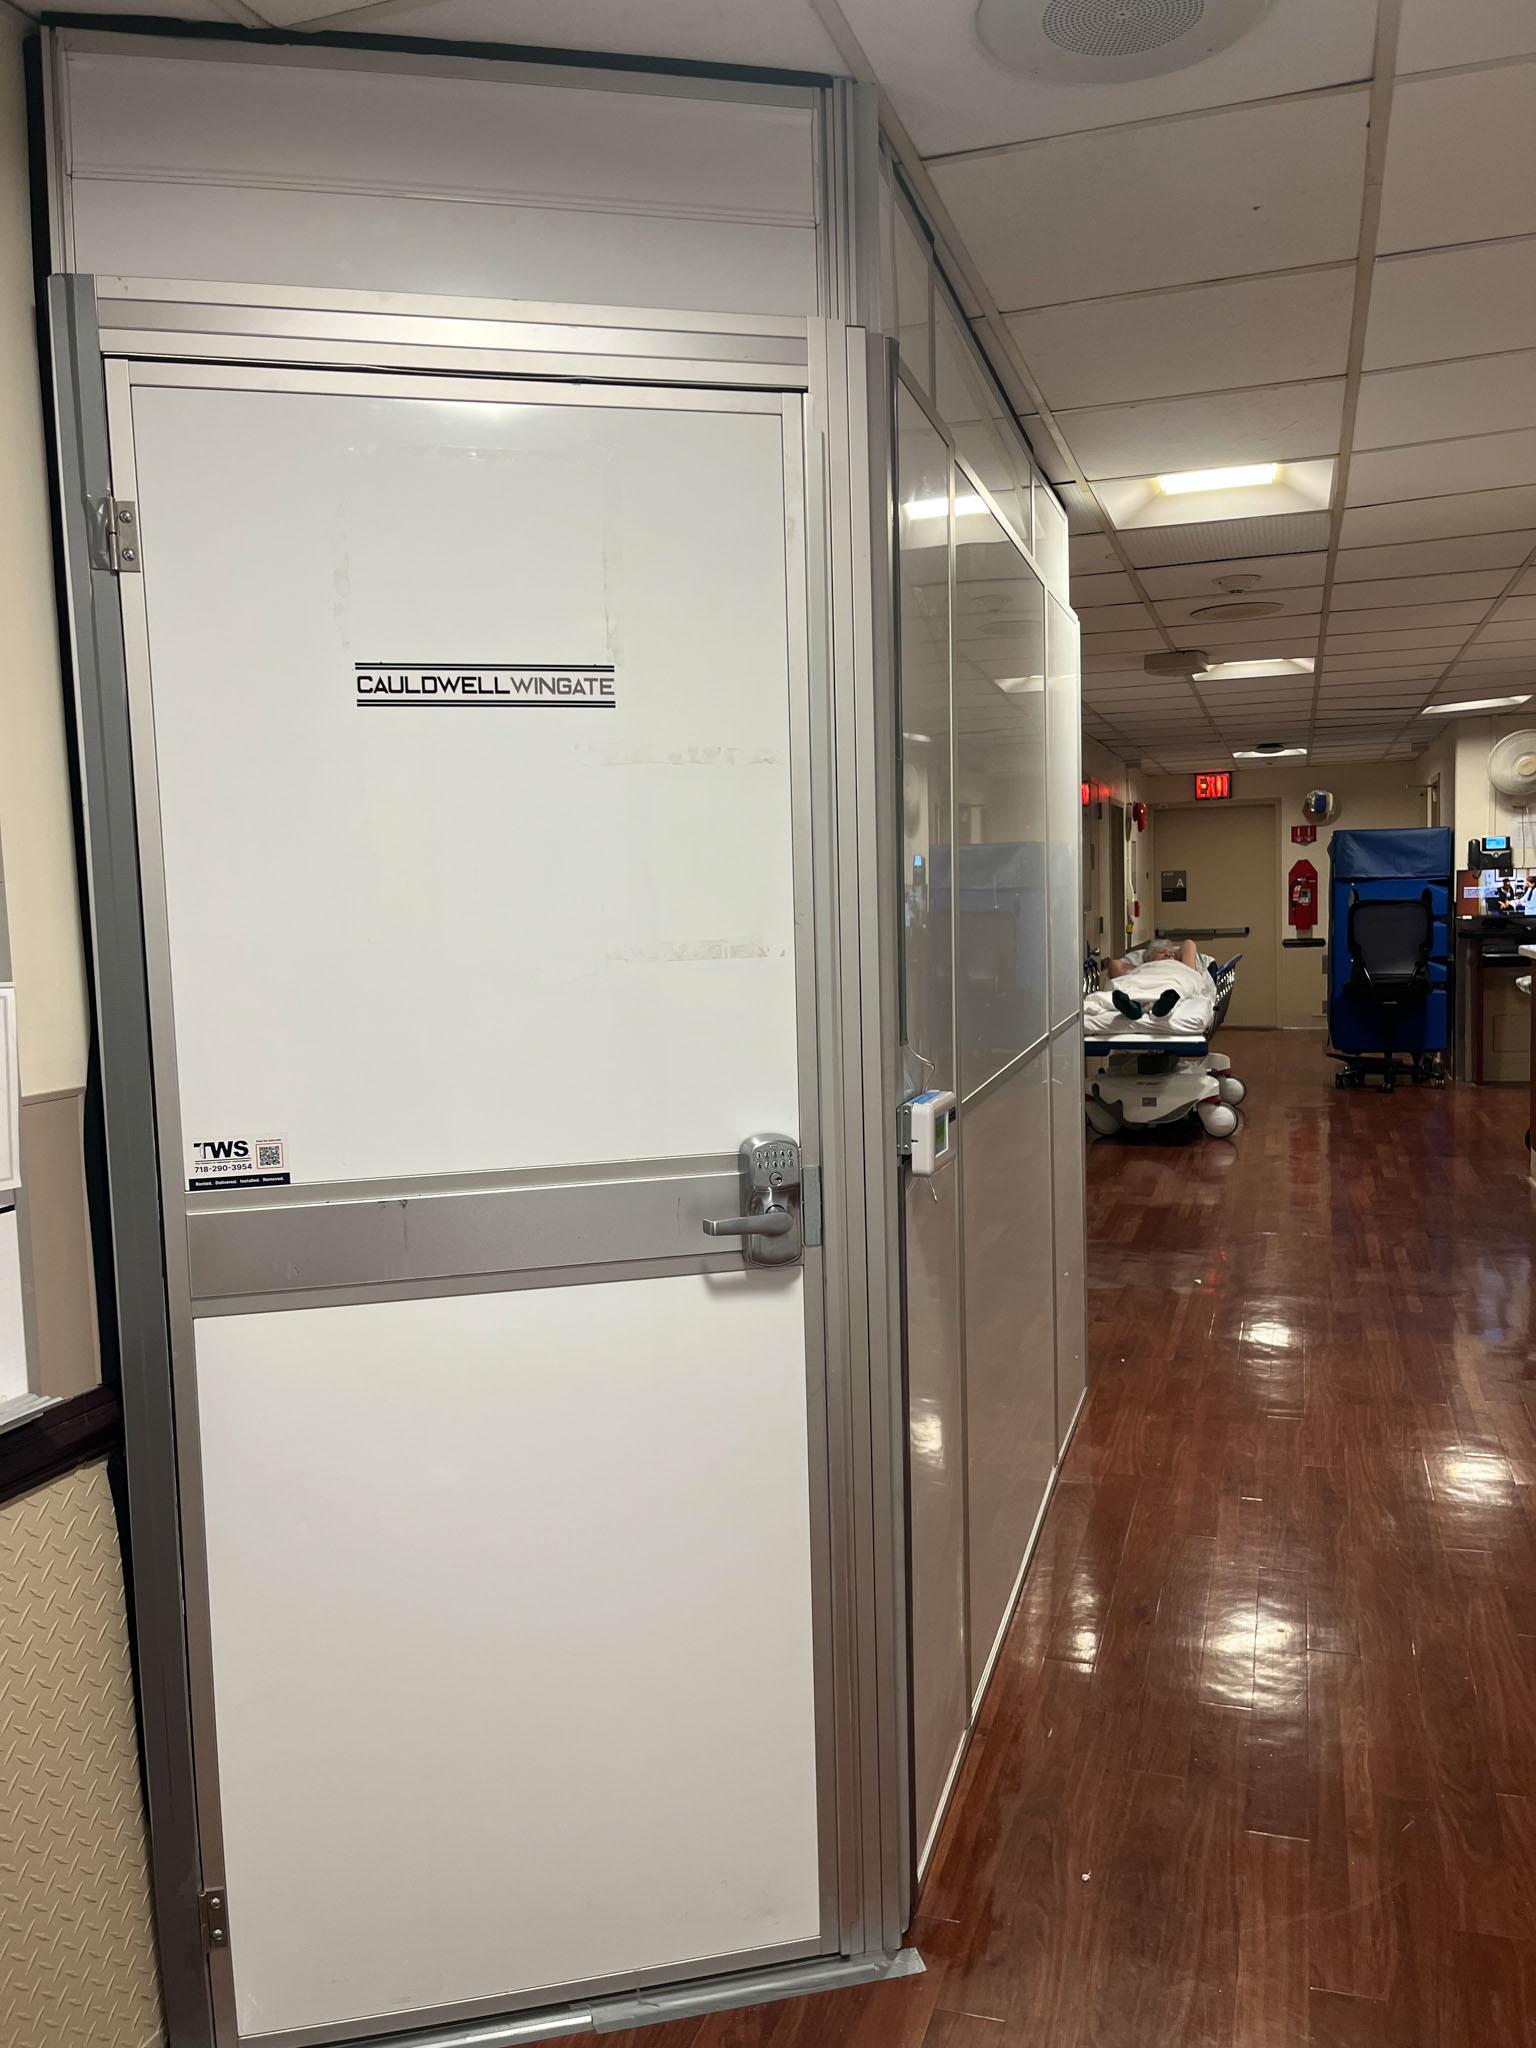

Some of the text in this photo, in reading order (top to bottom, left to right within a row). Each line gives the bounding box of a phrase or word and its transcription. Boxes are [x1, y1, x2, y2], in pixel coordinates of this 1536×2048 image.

[1196, 773, 1229, 798] EXIT
[1176, 878, 1184, 888] A
[194, 1163, 253, 1173] 718-290-3954
